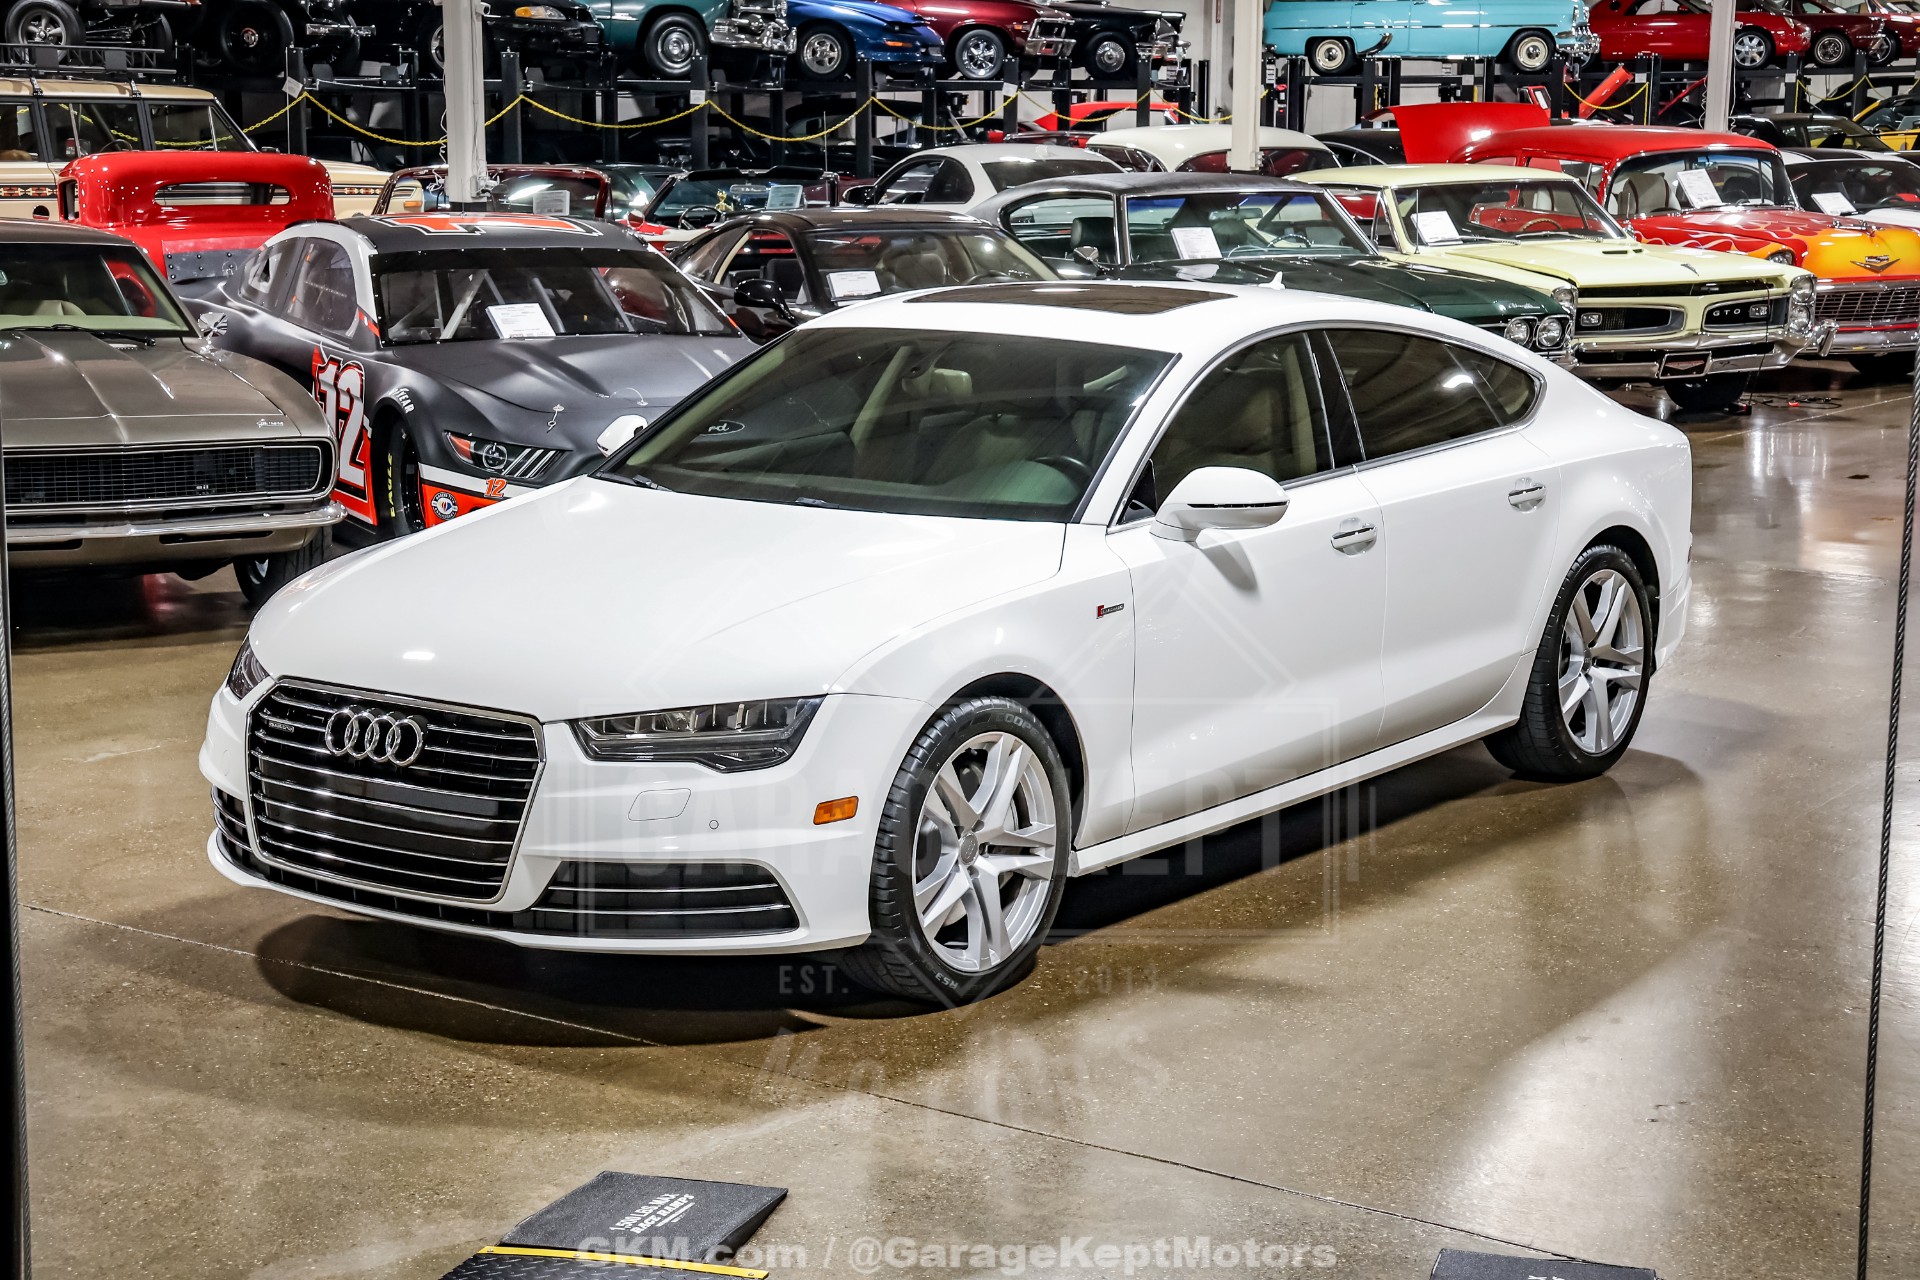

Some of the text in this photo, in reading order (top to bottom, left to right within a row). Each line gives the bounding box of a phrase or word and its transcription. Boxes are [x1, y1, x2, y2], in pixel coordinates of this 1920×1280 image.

[1712, 308, 1741, 317] GTO
[316, 357, 366, 492] 12
[485, 477, 507, 498] 12
